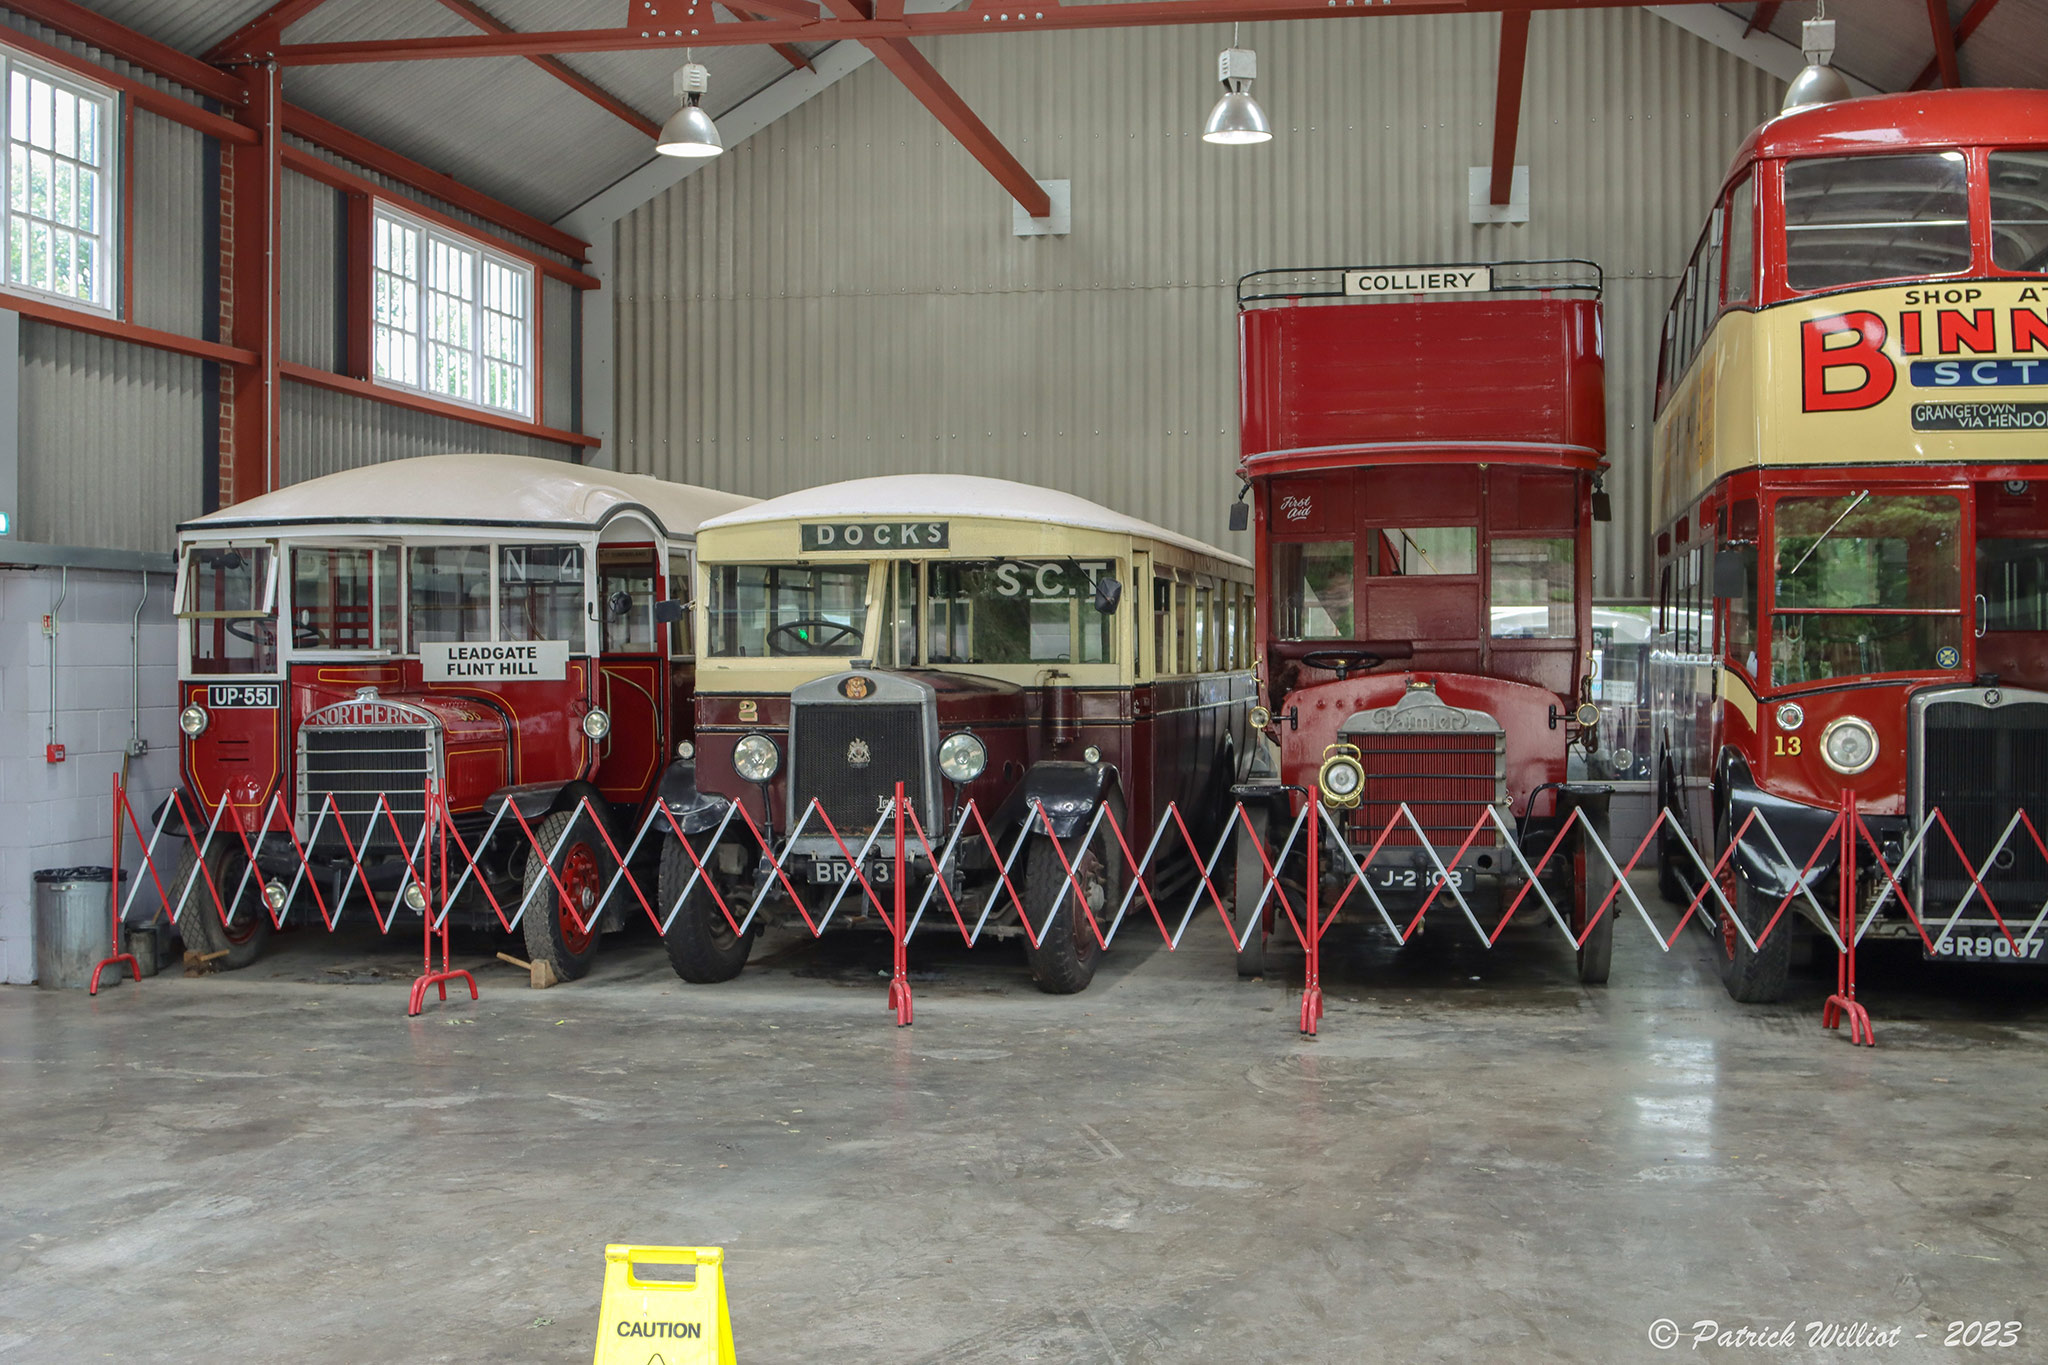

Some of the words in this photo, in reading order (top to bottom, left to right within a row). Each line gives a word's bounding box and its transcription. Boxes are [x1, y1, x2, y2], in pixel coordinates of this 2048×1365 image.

[1358, 272, 1476, 291] COLLIERY
[1905, 289, 1982, 305] SHOP
[1915, 404, 2016, 422] GRANGETOWN
[1958, 417, 1984, 428] VIA
[1988, 411, 2048, 428] HENDO
[1280, 496, 1311, 510] First
[817, 522, 942, 545] DOCKS
[506, 549, 526, 581] N
[561, 549, 581, 579] 4
[448, 646, 537, 660] LEADGATE
[447, 663, 495, 676] FLINT
[500, 662, 538, 675] HILL
[316, 704, 413, 725] NORTHERN
[738, 700, 758, 722] 2
[1774, 736, 1802, 756] 13
[616, 1321, 701, 1339] CAUTION
